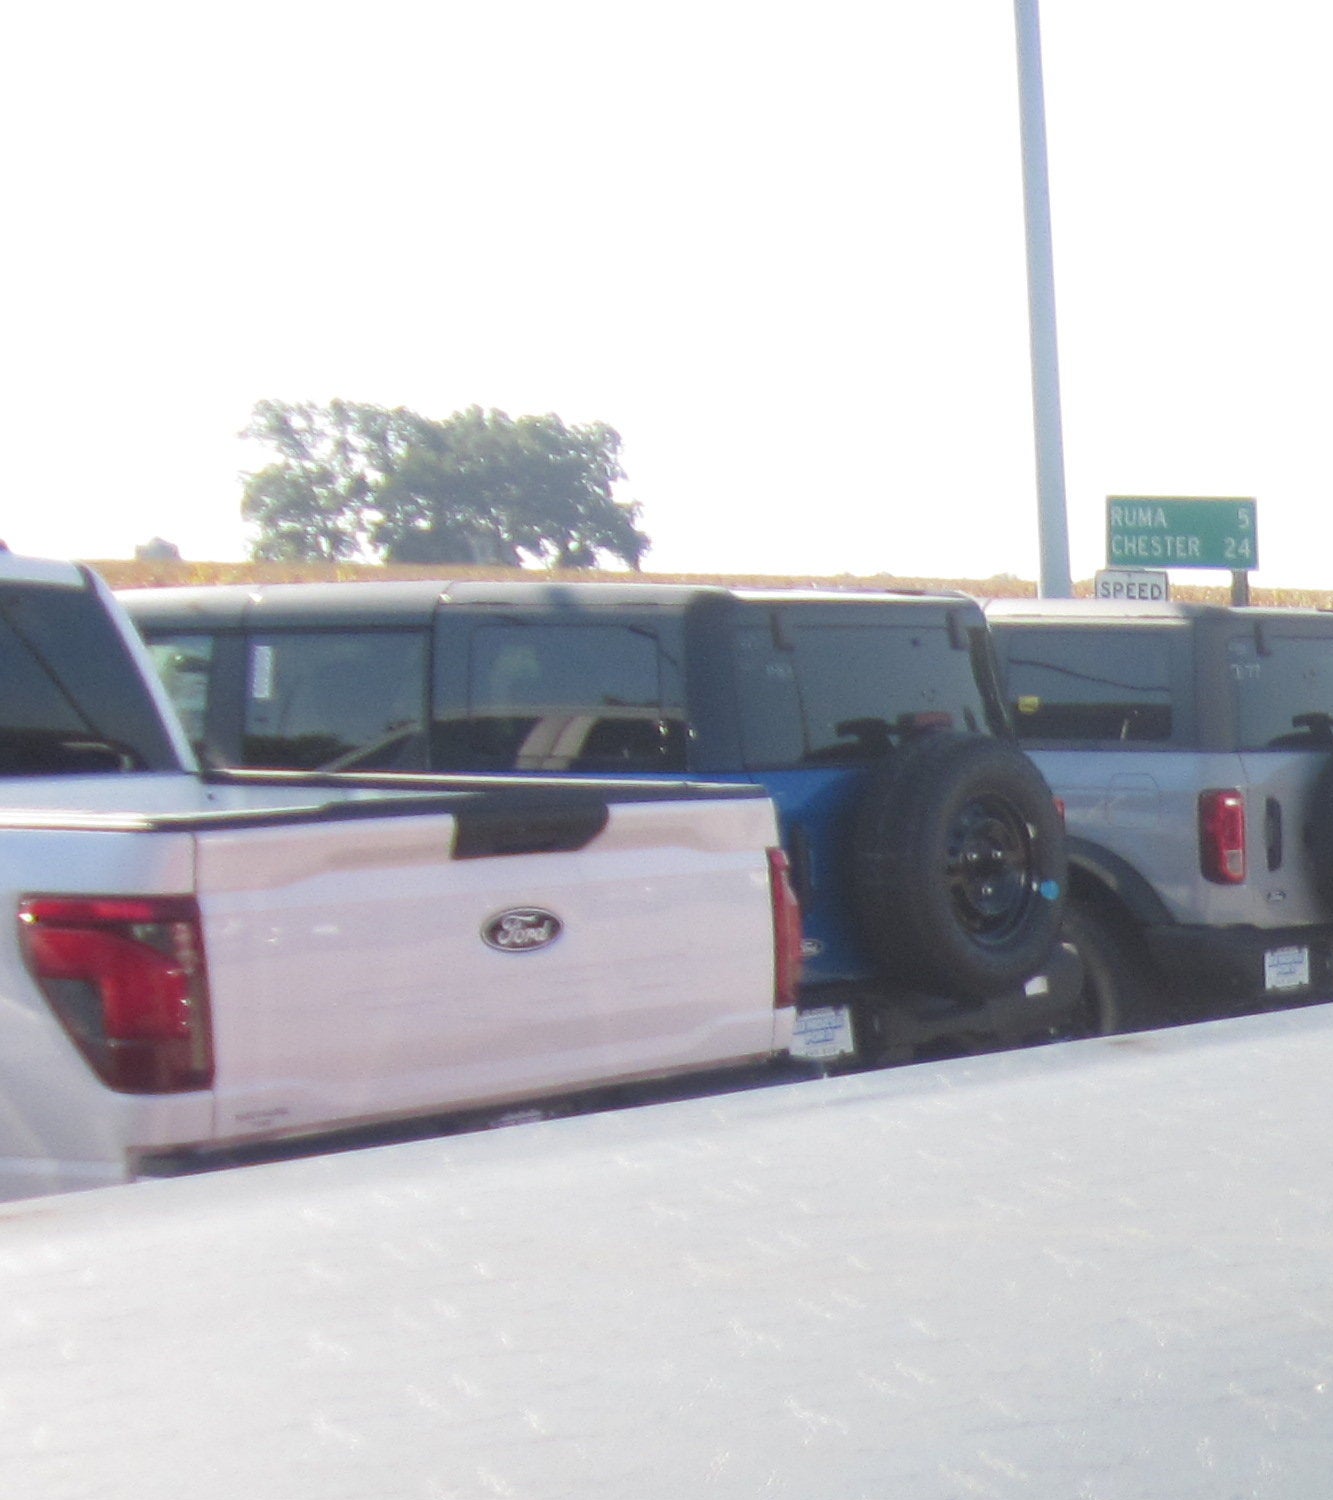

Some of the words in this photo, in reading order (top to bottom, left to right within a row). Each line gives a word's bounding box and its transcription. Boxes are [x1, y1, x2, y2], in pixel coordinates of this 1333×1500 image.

[1111, 506, 1167, 529] RUMA
[1237, 508, 1250, 529] 5
[1111, 535, 1200, 557] CHESTER
[1224, 537, 1250, 558] 24
[1101, 581, 1162, 600] SPEED
[498, 914, 553, 945] Ford
